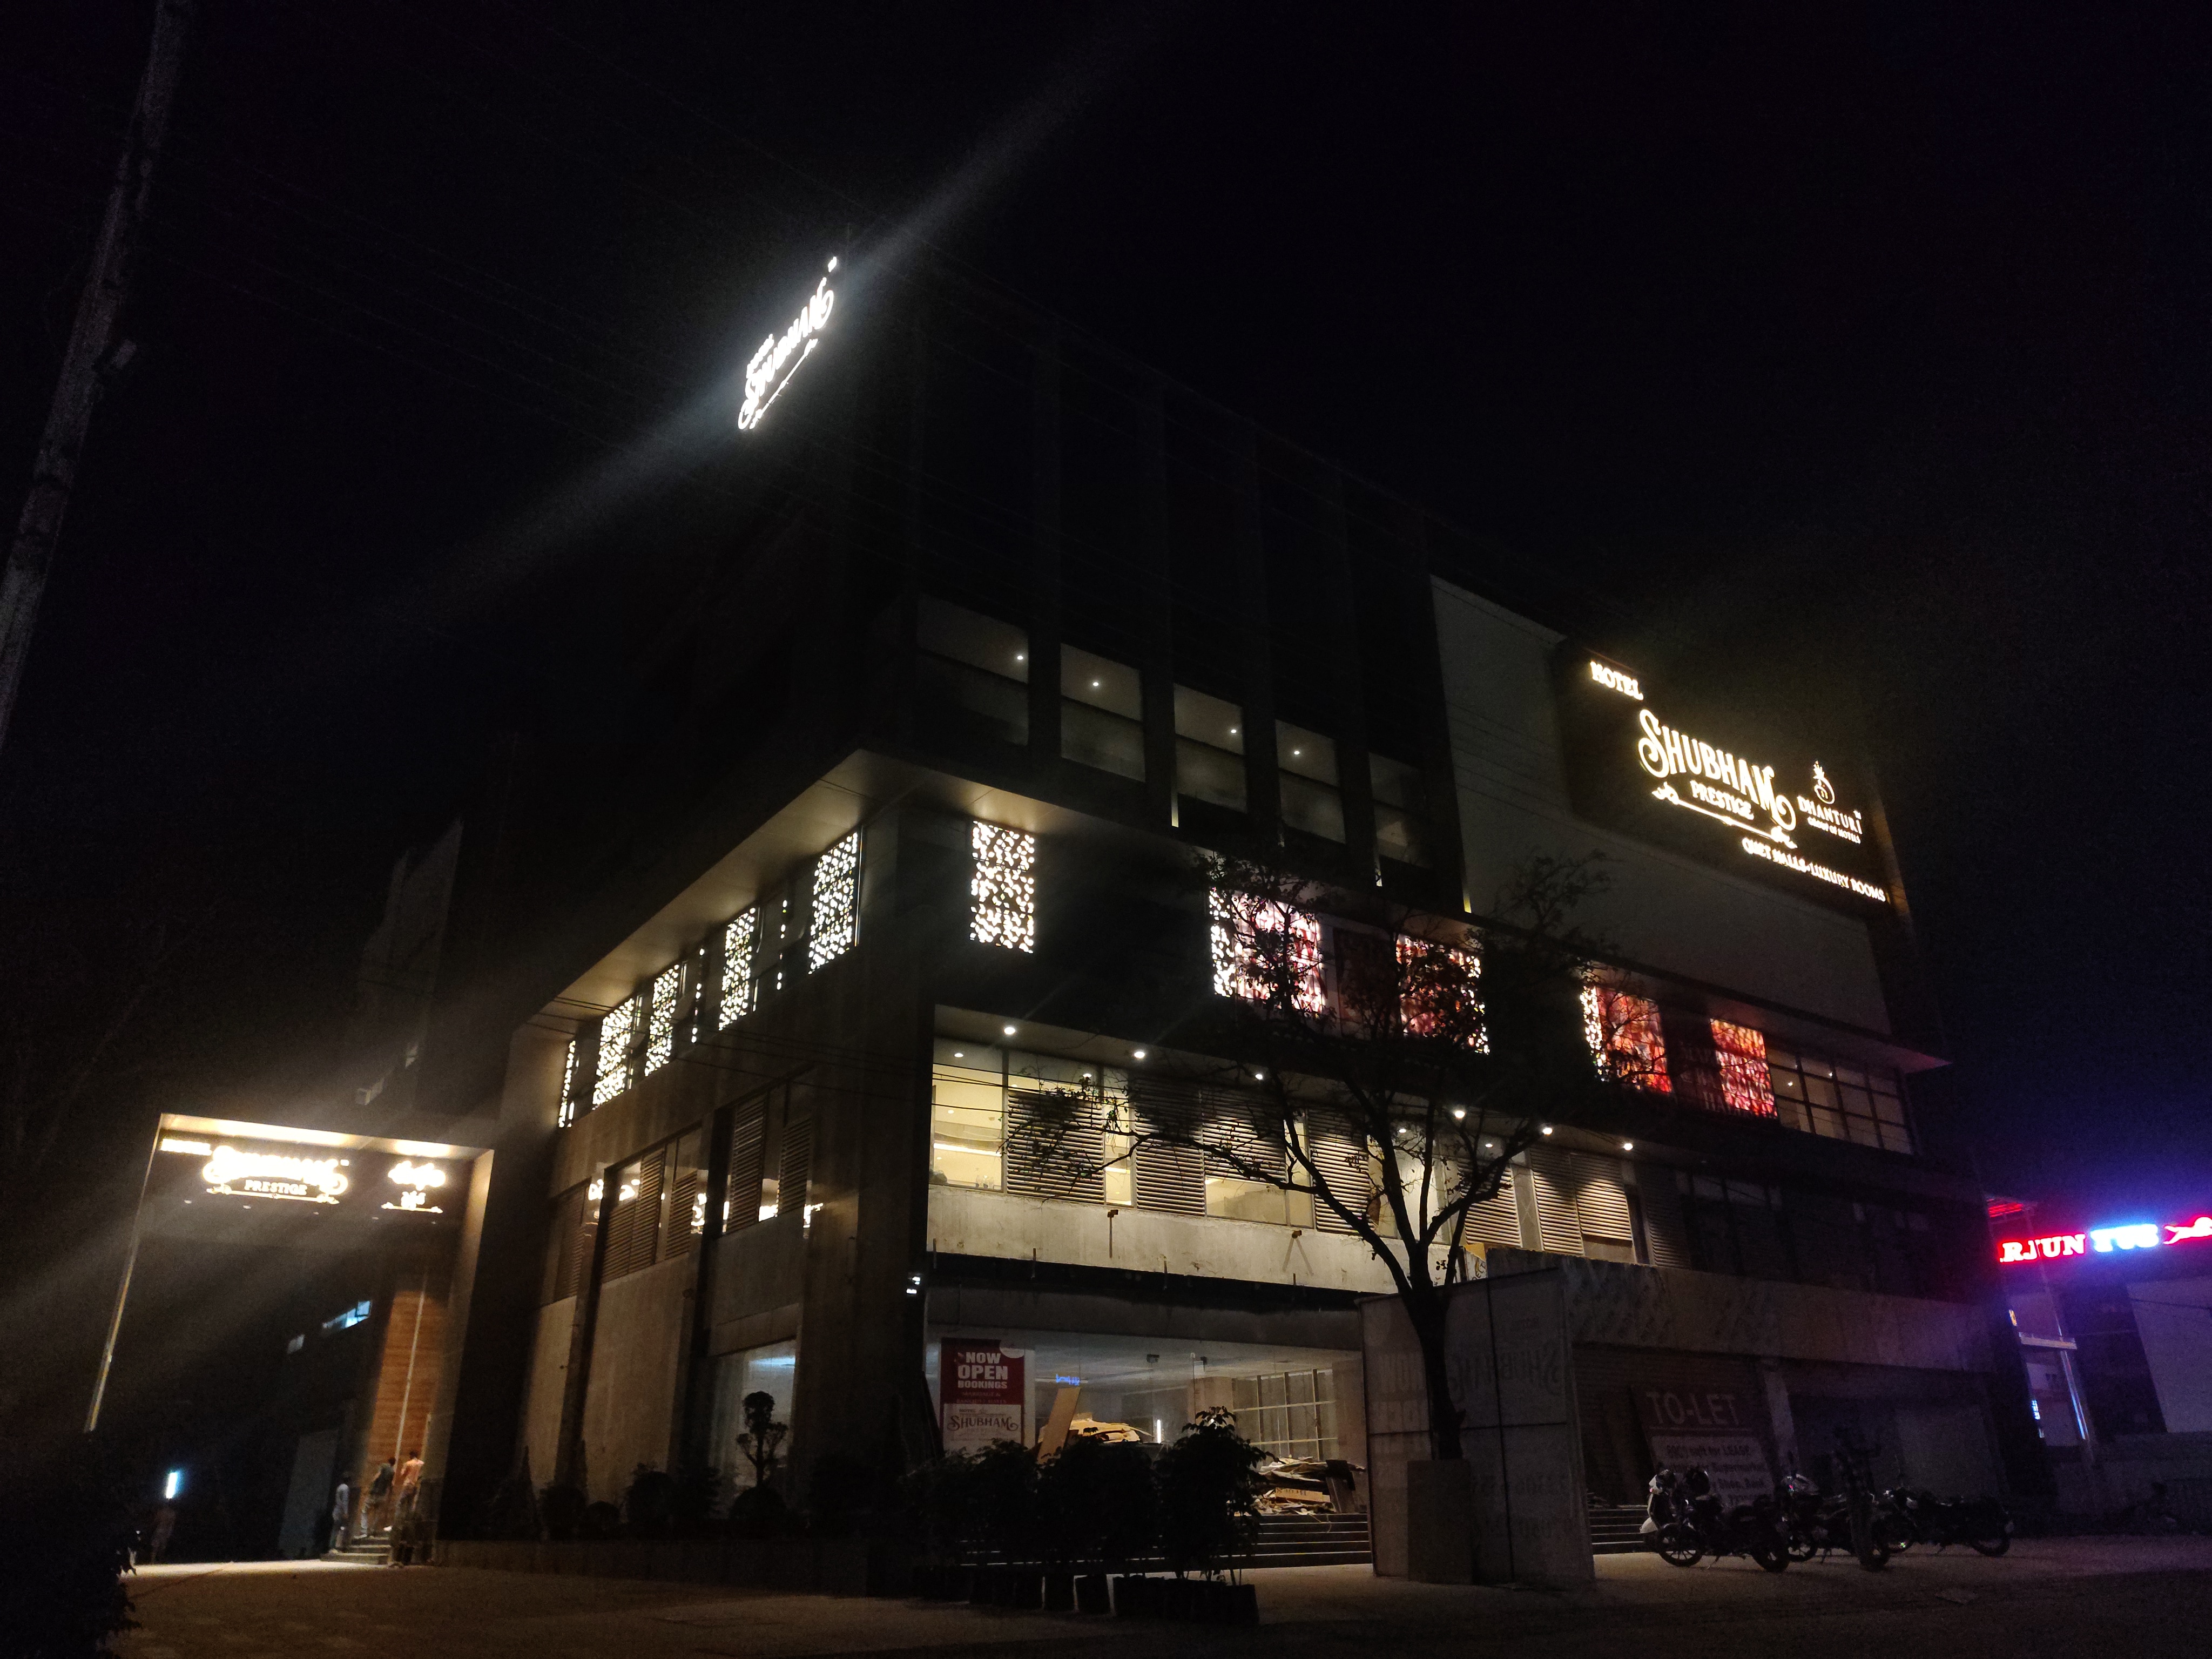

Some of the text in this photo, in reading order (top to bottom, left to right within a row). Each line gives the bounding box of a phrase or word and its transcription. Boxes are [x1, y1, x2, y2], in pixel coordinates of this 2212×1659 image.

[1590, 661, 1644, 700] HOTEL
[1638, 709, 1797, 831] SHUBHAM
[1690, 780, 1754, 820] PRESTIGE
[1797, 795, 1863, 834] DHANTURI
[1850, 878, 1886, 901] ROOMS
[244, 1179, 308, 1196] PRESTIGE
[2000, 1233, 2086, 1263] RJUN
[966, 1352, 1001, 1364] NOW
[957, 1365, 1008, 1380] OPEN
[957, 1381, 1008, 1389] BOOKINGS
[1647, 1391, 1739, 1426] TO-LET
[947, 1415, 1019, 1431] SHUBHAM
